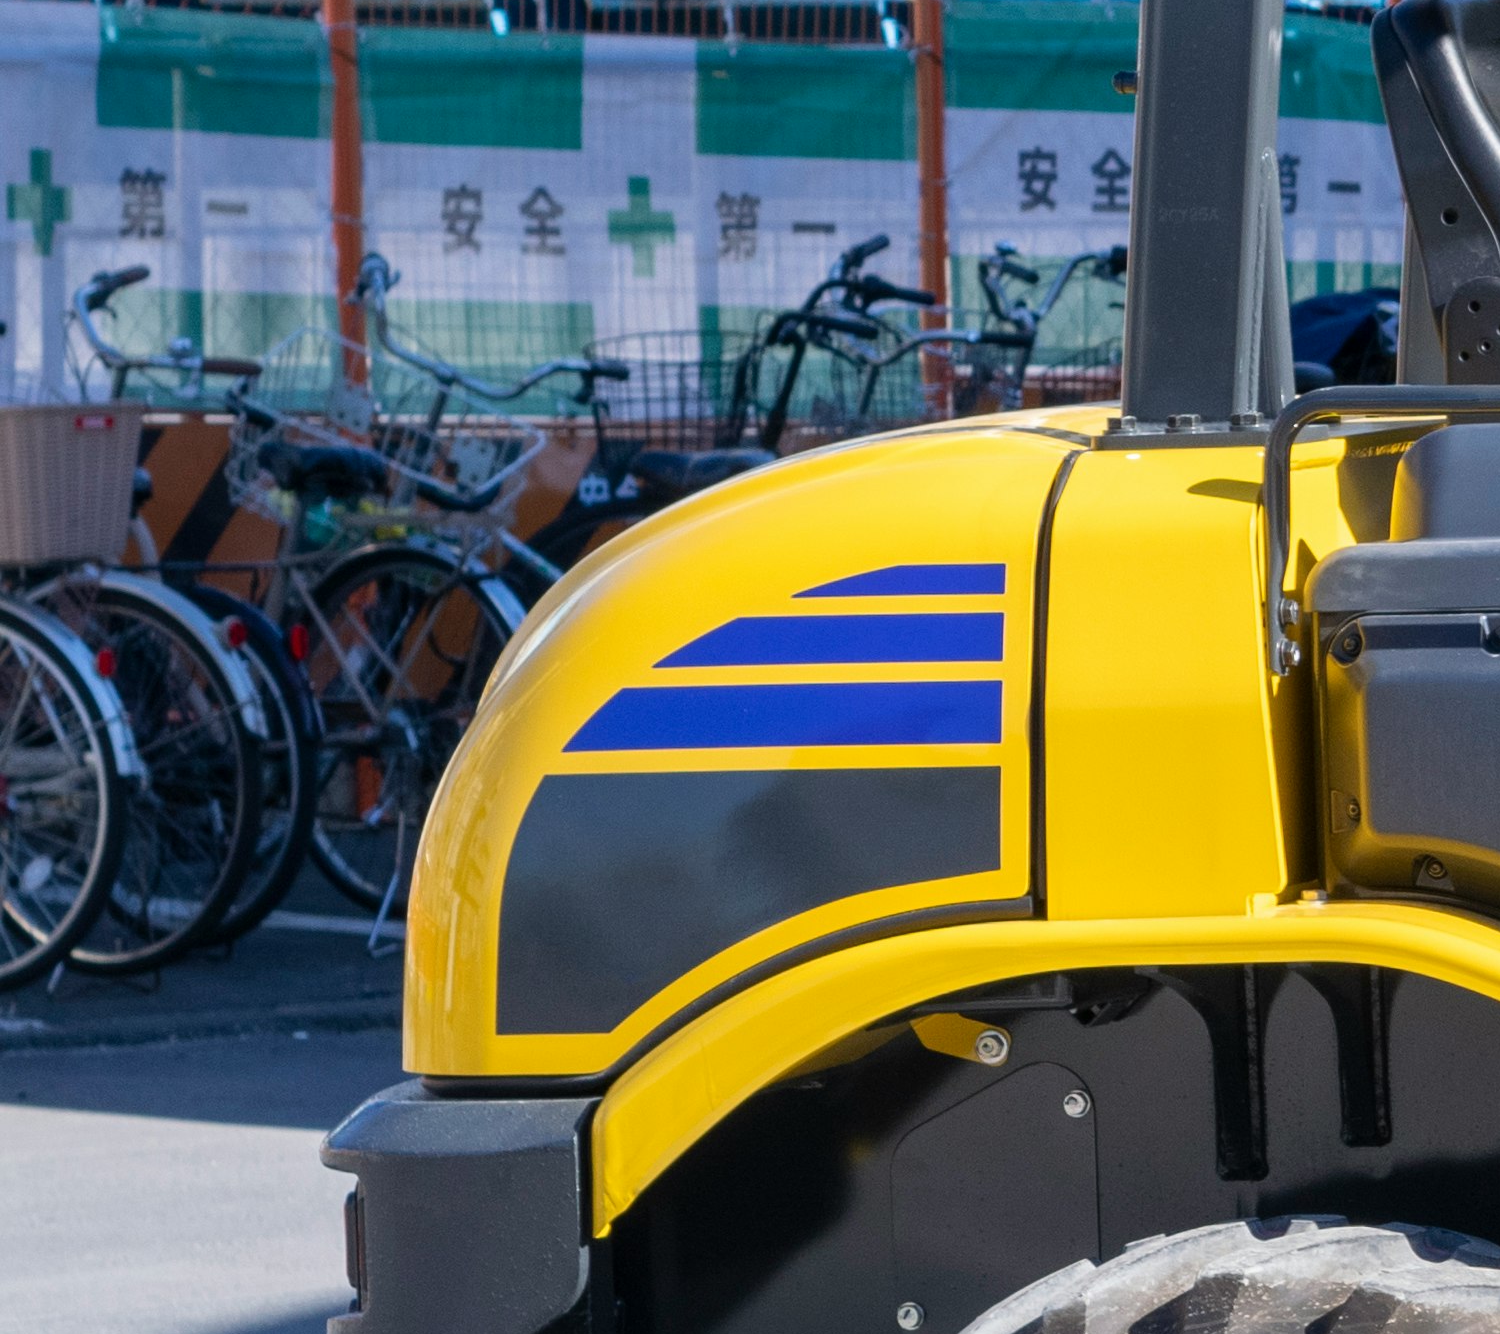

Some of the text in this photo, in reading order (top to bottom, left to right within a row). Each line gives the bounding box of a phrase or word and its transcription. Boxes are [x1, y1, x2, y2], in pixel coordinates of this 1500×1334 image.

[119, 168, 249, 239] 第一
[1017, 146, 1132, 213] 安全
[441, 184, 566, 255] 安全
[715, 190, 836, 261] 第一
